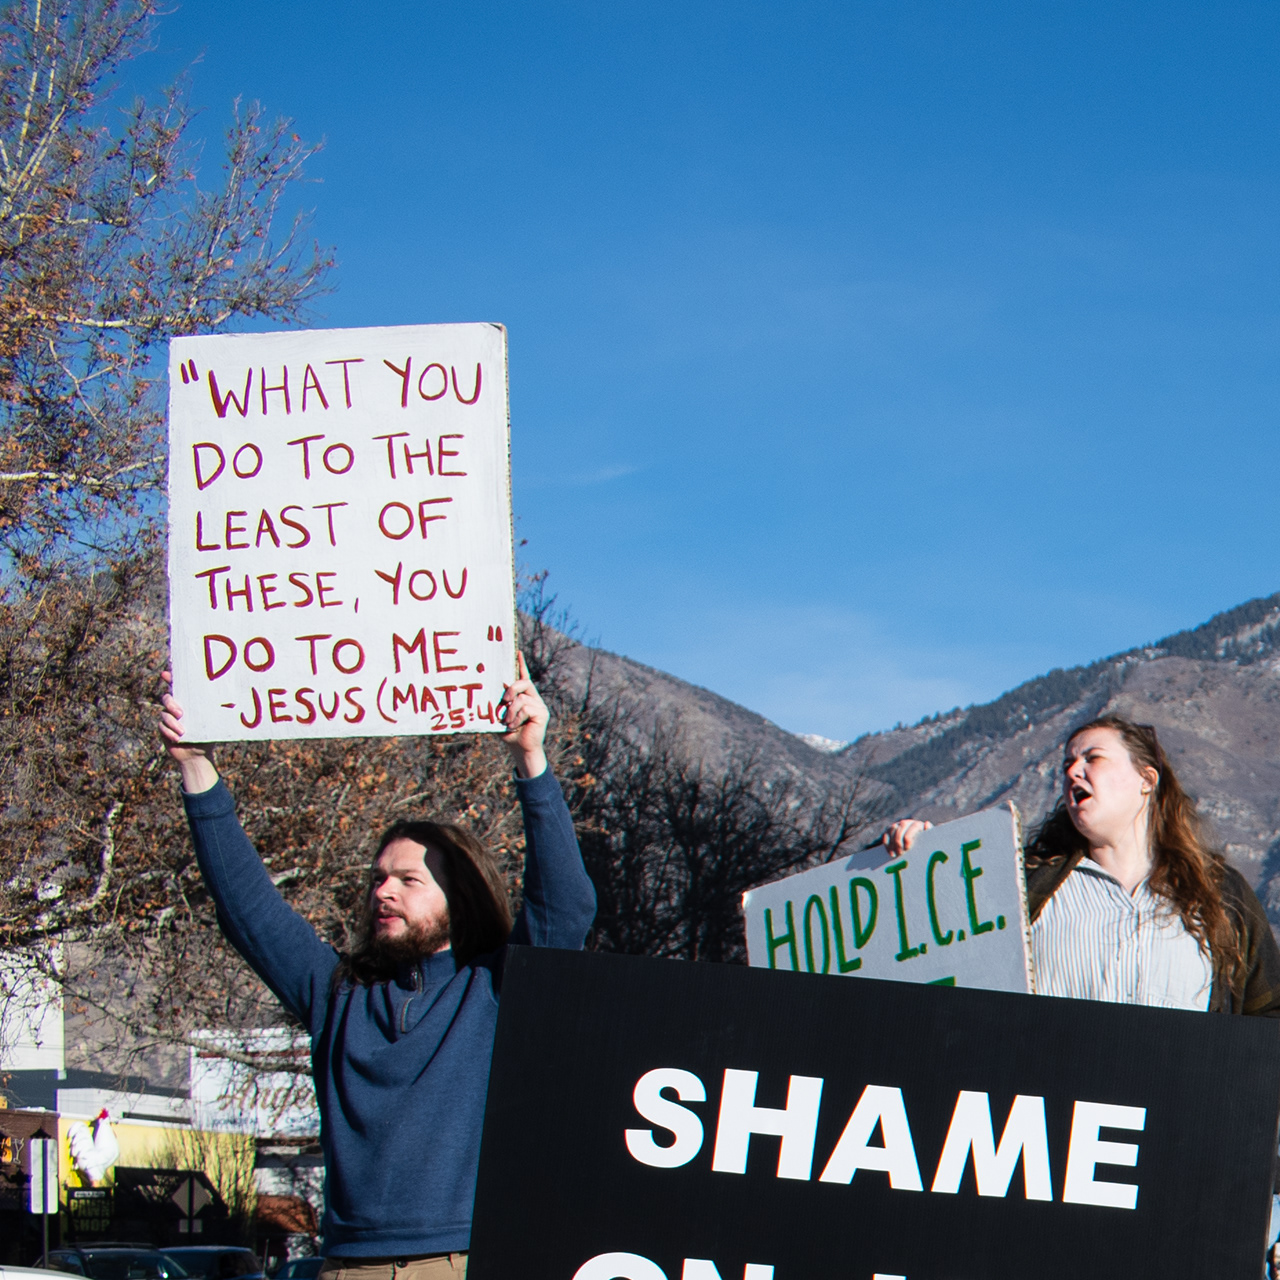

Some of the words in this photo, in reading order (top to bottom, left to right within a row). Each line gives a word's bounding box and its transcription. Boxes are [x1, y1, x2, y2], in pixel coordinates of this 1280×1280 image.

[181, 358, 365, 419] "WHAT
[383, 356, 483, 408] YOU
[192, 442, 264, 490] DO
[287, 434, 355, 479] TO
[373, 433, 468, 479] THE
[196, 501, 349, 551] LEAST
[378, 497, 454, 542] OF
[195, 566, 361, 614] THESE,
[374, 561, 468, 606] YOU
[204, 633, 275, 681] DO
[295, 633, 366, 675] TO
[392, 626, 504, 675] ME."
[764, 876, 879, 974] HOLD
[885, 839, 1006, 962] I.C.E.
[625, 1067, 1147, 1210] SHAME
[72, 1218, 111, 1232] SHOP
